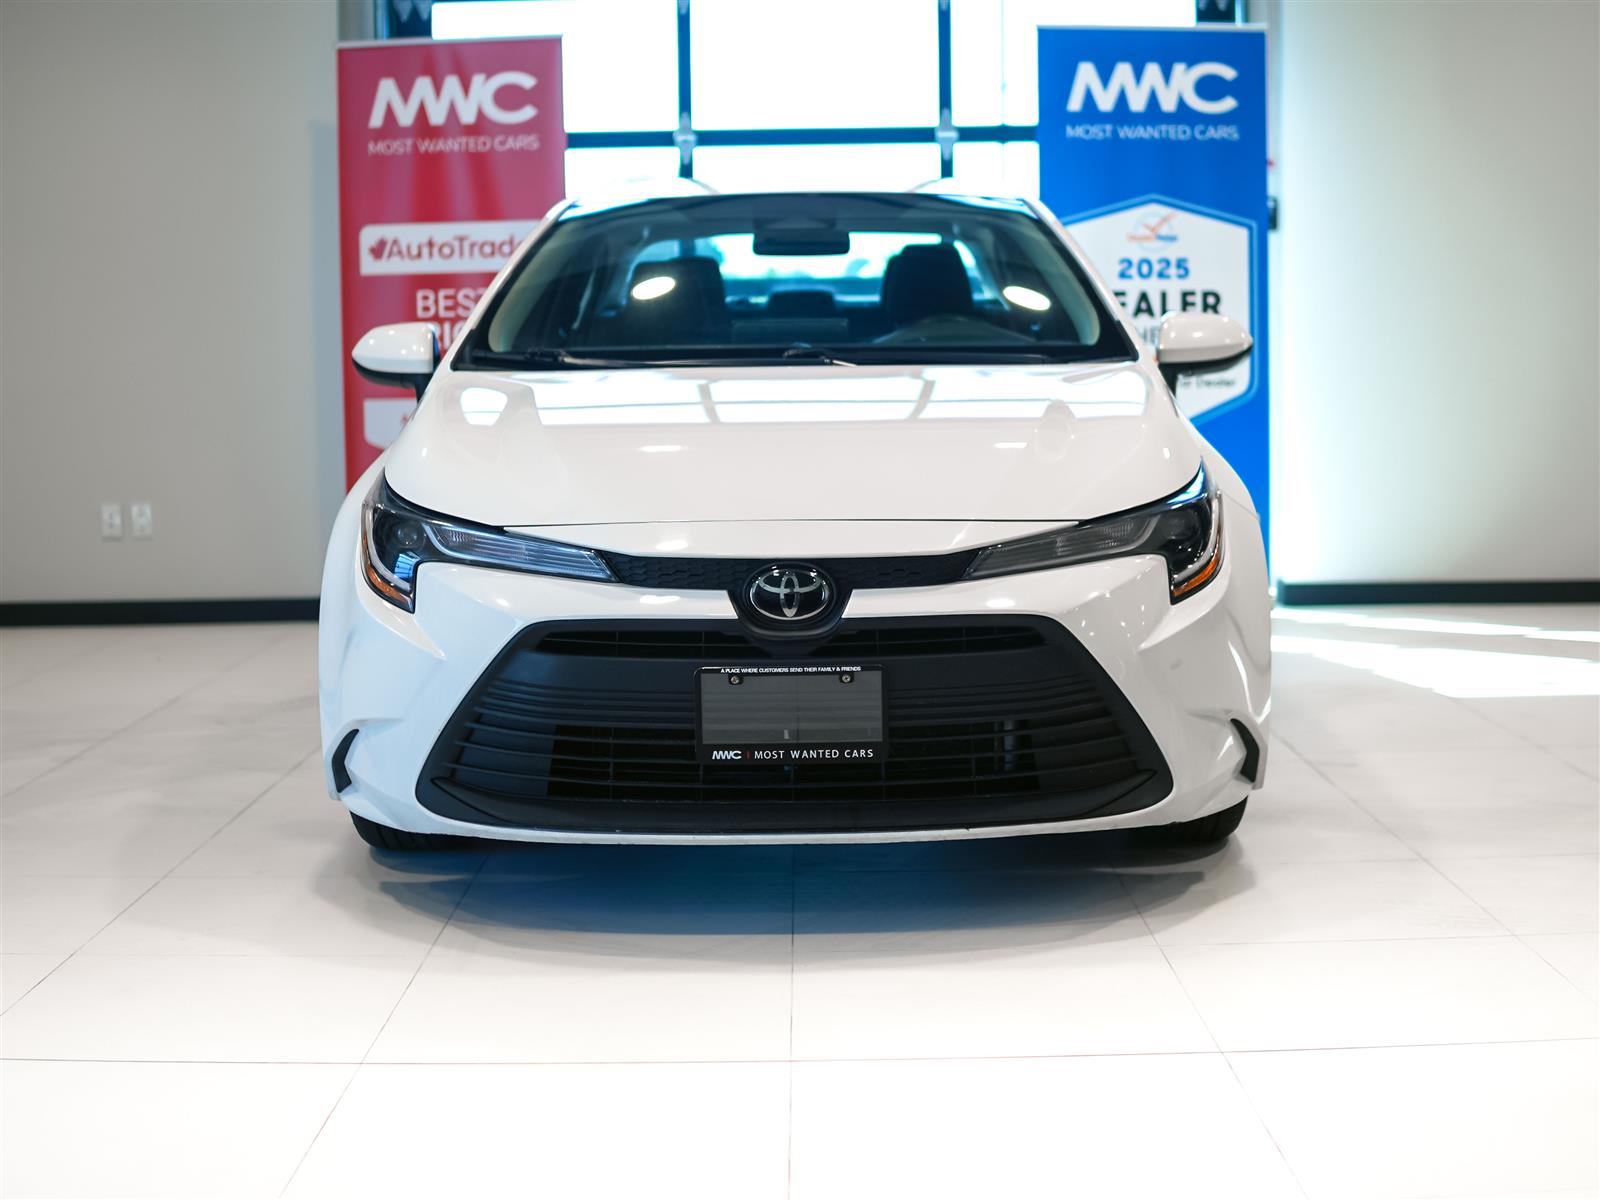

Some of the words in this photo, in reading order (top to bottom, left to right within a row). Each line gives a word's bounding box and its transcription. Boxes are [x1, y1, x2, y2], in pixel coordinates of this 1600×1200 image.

[368, 71, 538, 129] MWC
[1066, 61, 1239, 115] MWC
[1066, 124, 1113, 140] MOST
[1117, 124, 1191, 141] WANTED
[1194, 124, 1240, 141] CARS
[368, 139, 413, 156] MOST
[416, 136, 490, 154] WANTED
[493, 134, 540, 151] CARS
[386, 234, 523, 261] AutoTrad
[1118, 258, 1190, 280] 2025
[1112, 290, 1223, 319] EALER
[712, 751, 742, 760] MWC
[755, 751, 785, 759] MOST
[790, 750, 839, 759] WANTED
[844, 749, 874, 758] CARS
